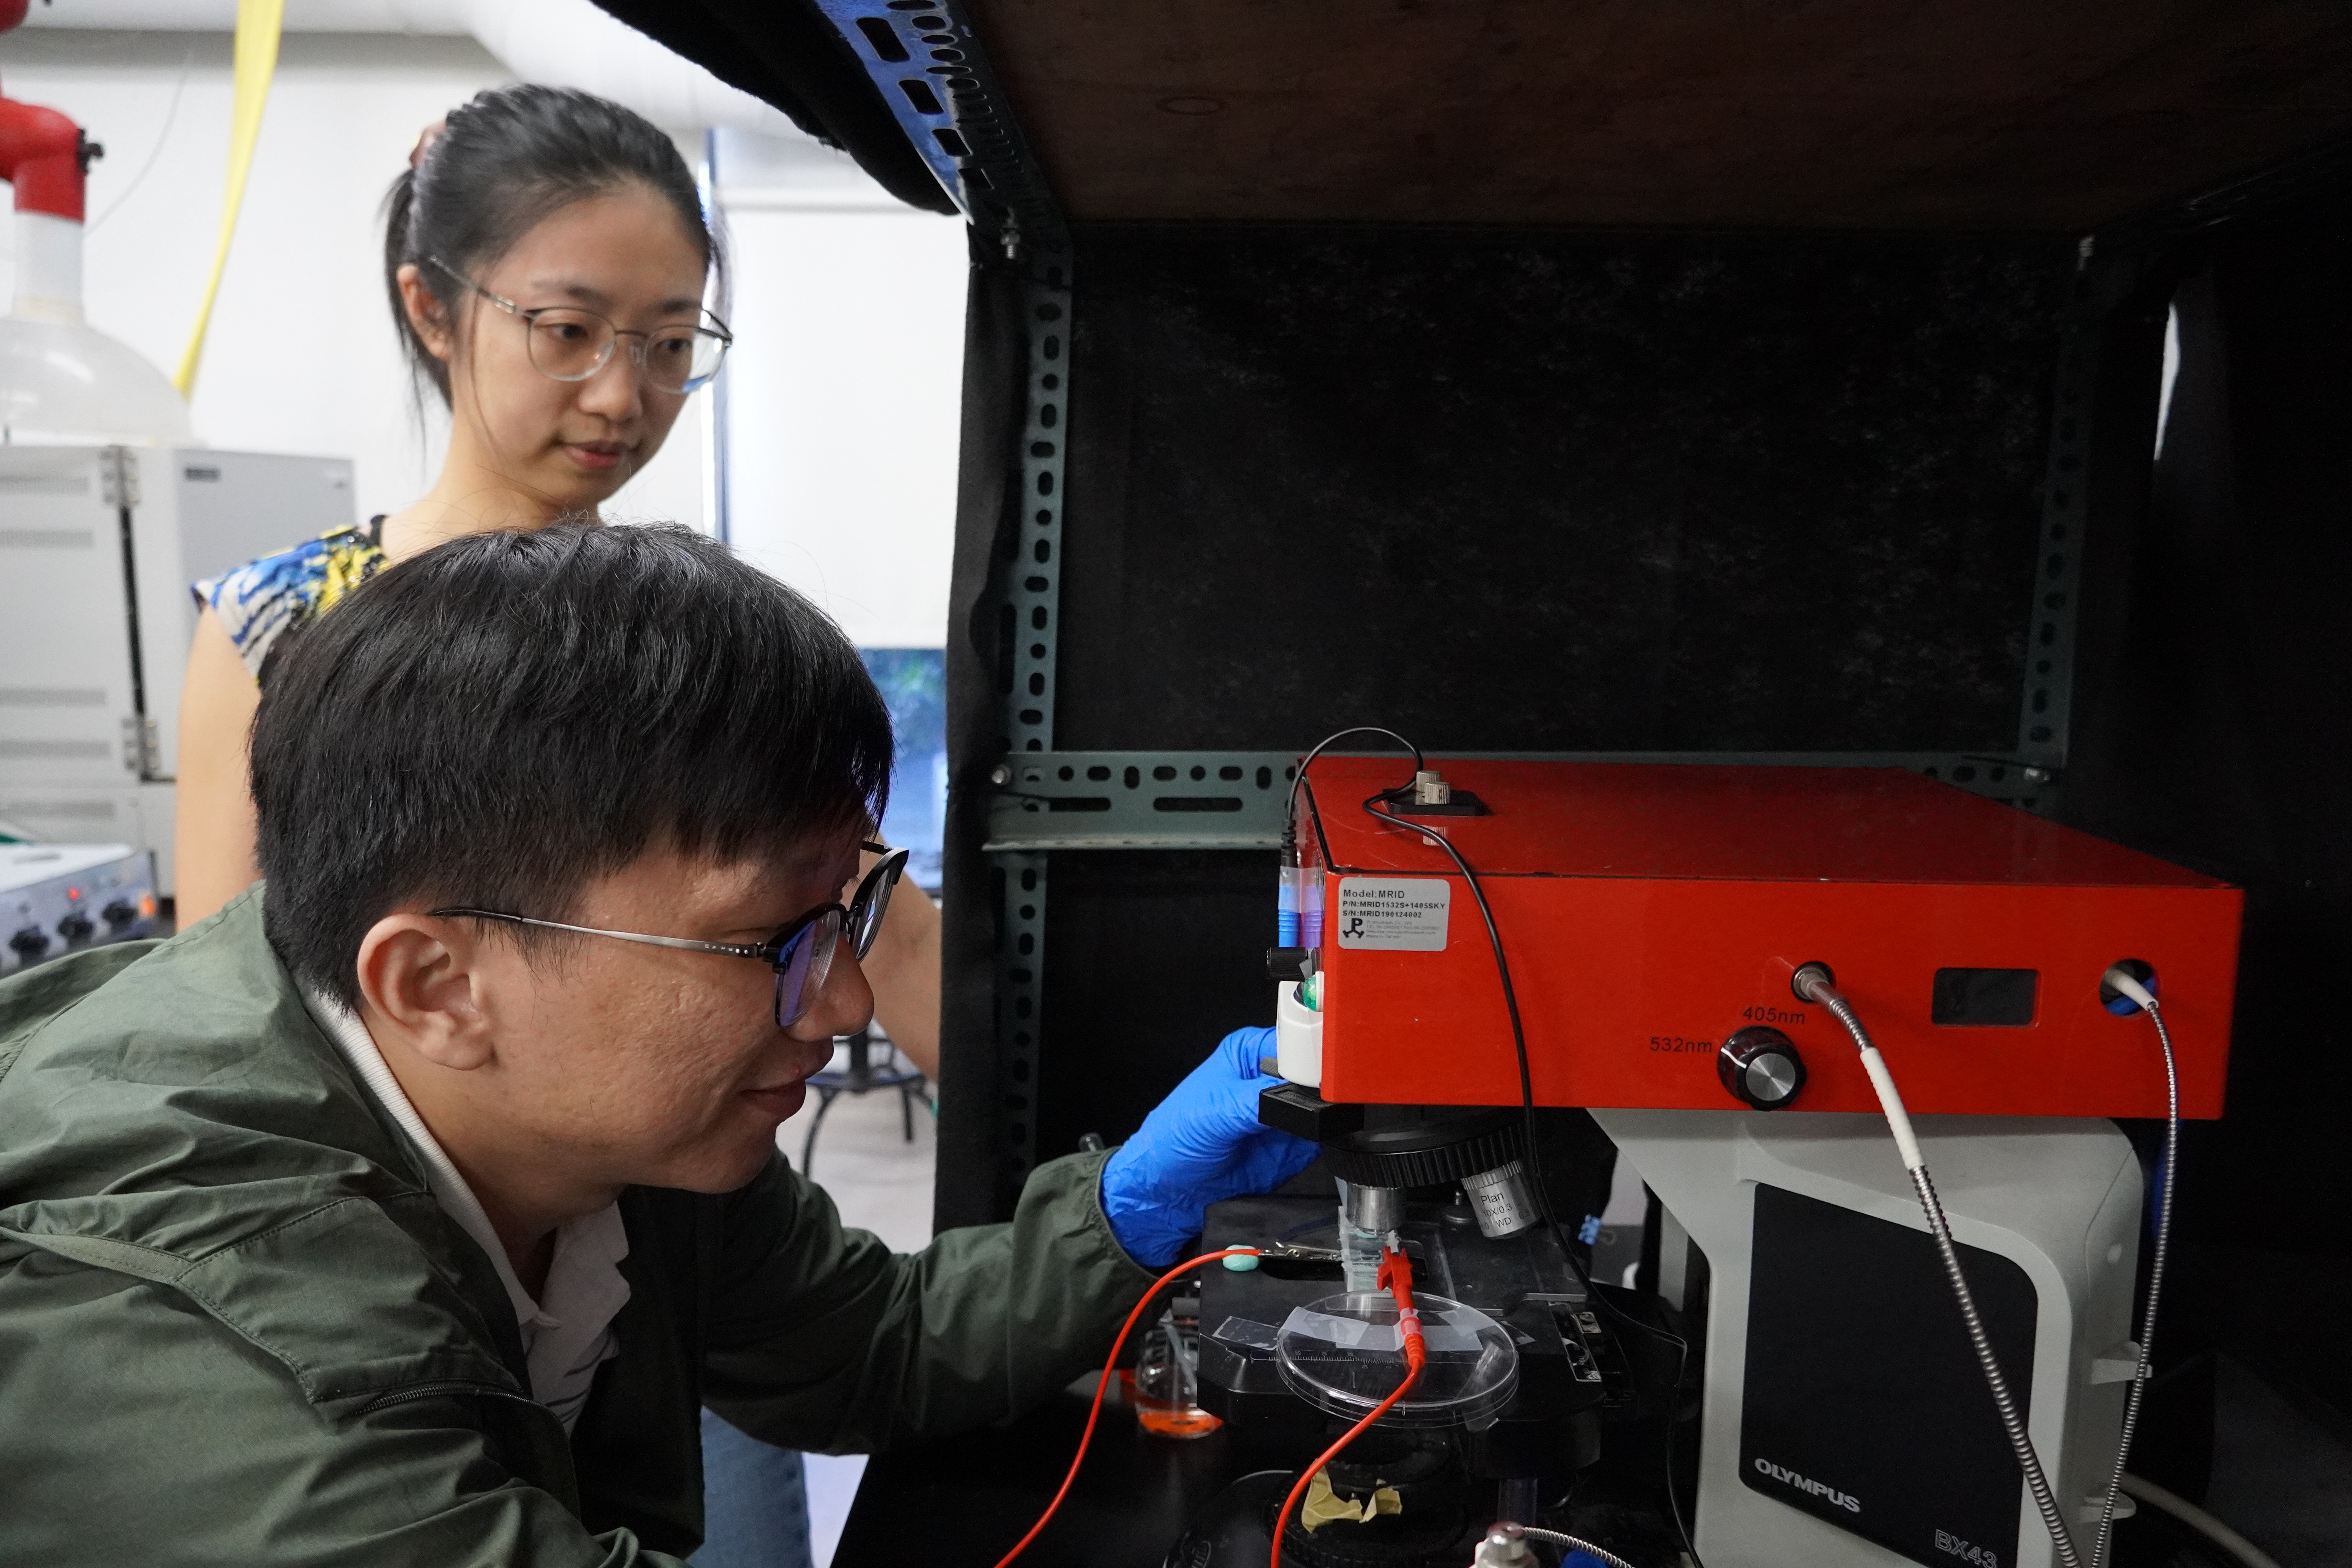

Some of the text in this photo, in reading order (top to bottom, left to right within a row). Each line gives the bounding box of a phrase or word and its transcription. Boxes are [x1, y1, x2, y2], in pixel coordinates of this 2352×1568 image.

[1743, 1007, 1805, 1024] 405nm
[1650, 1037, 1712, 1053] 532nm
[1480, 1192, 1504, 1205] Plan
[1483, 1203, 1512, 1218] 10X/0.3
[1496, 1217, 1512, 1227] WD
[1754, 1458, 1860, 1513] OLYMPUS
[1935, 1529, 1997, 1568] BX43
